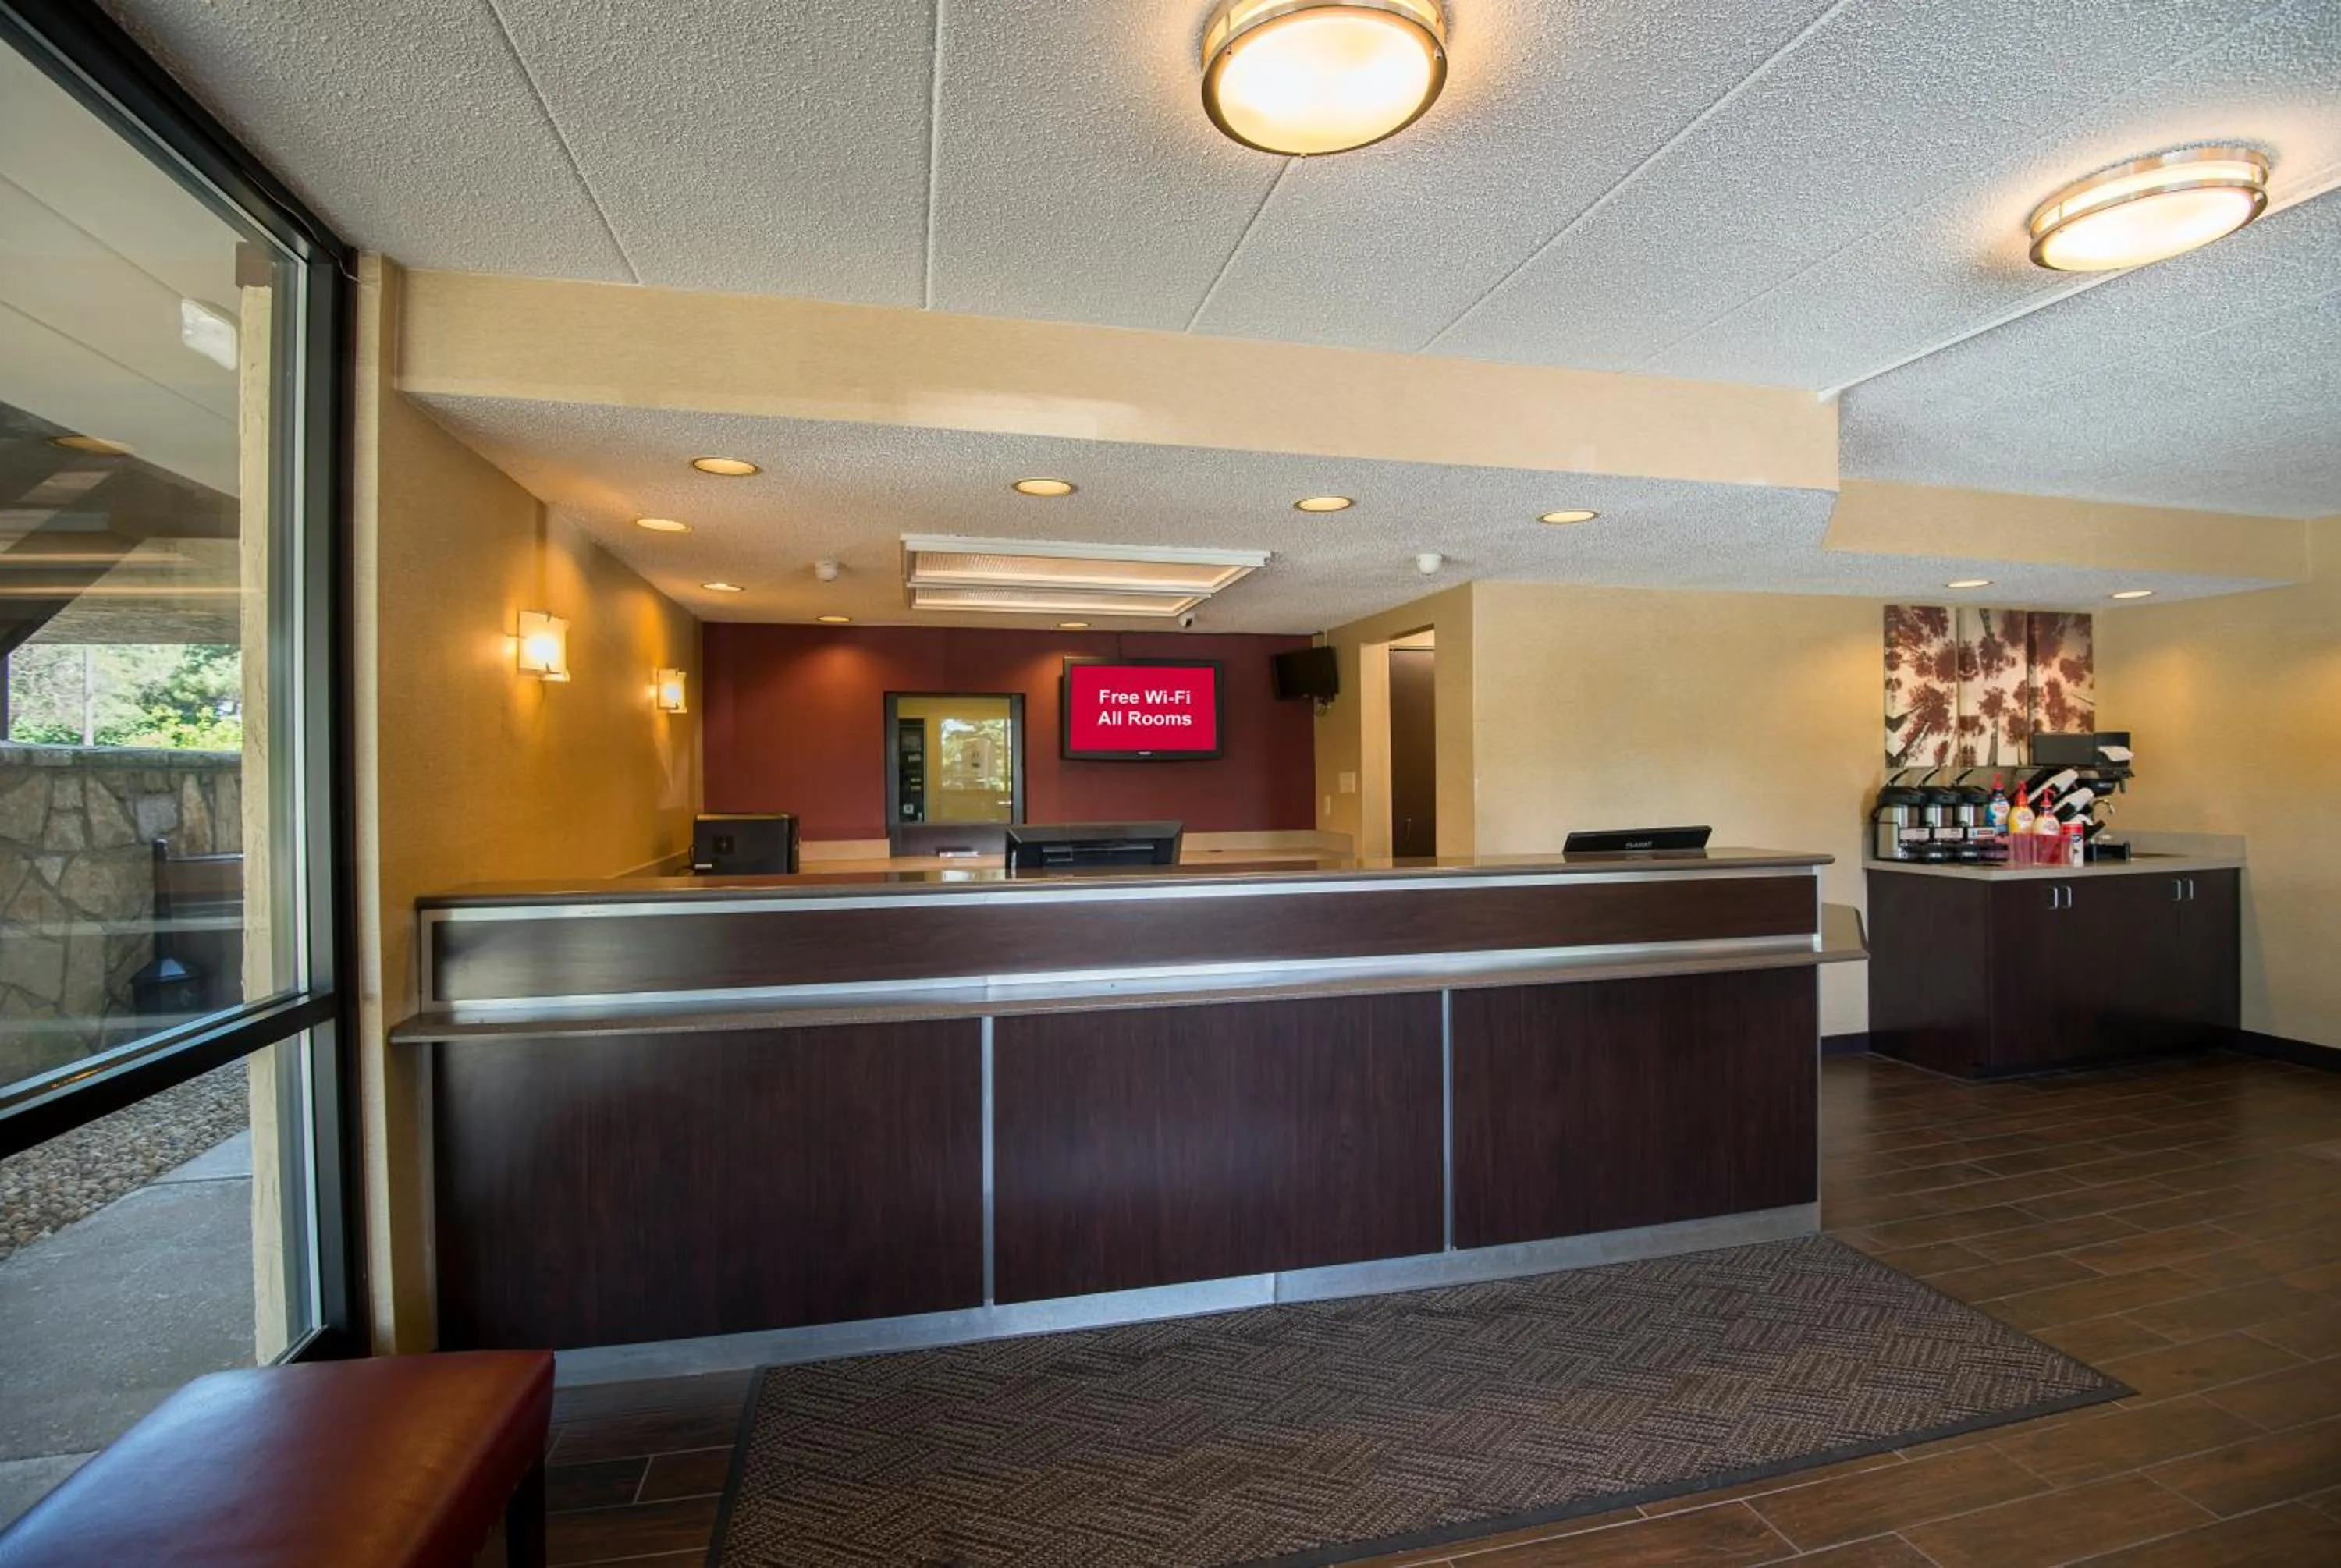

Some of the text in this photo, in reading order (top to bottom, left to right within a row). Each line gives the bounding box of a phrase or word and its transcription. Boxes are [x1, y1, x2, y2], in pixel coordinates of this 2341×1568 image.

[1099, 689, 1192, 705] Free Wi-Fi
[1097, 711, 1192, 727] All Rooms
